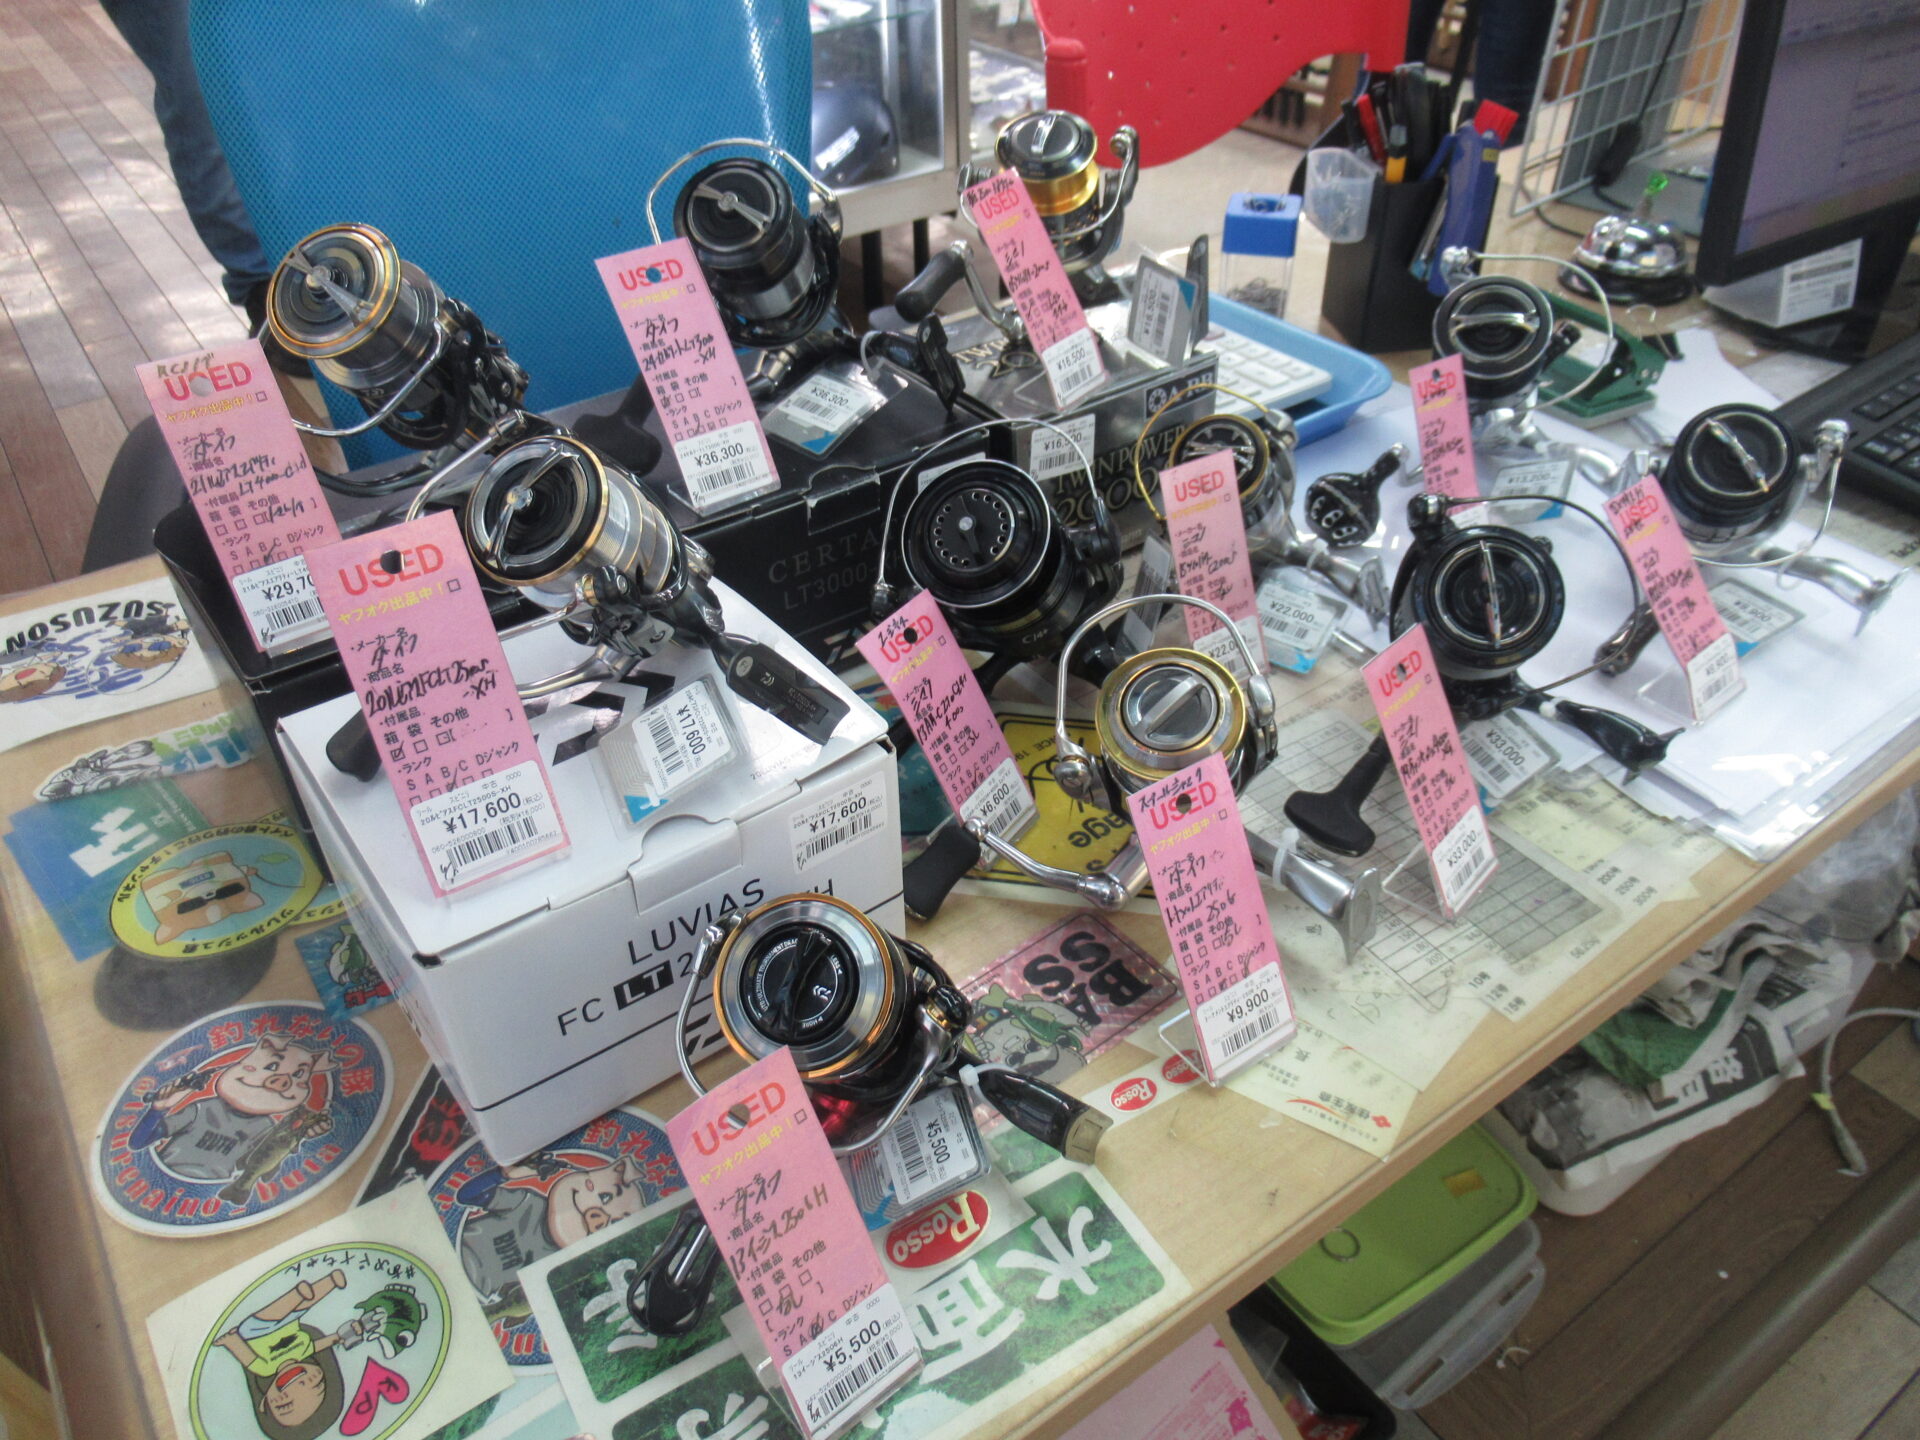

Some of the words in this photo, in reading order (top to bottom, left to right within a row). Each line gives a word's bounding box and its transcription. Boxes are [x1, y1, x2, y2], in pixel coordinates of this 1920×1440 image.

[979, 189, 1020, 219] USED
[618, 259, 684, 291] USED
[163, 362, 252, 401] UED
[810, 386, 849, 407] ¥36,300
[1417, 373, 1457, 399] USED
[694, 442, 744, 468] ¥36,300
[1174, 471, 1225, 502] USED
[1621, 495, 1659, 531] USED
[338, 543, 444, 596] USED
[768, 528, 884, 584] CERTA
[338, 583, 443, 626] ヤフオク出品中！
[1269, 600, 1315, 625] ¥22,000
[1, 600, 167, 655] SUZUSON
[880, 615, 933, 663] USED
[1379, 650, 1423, 697] USED
[384, 731, 399, 746] 箱
[407, 723, 422, 738] 袋
[430, 707, 470, 728] その他
[676, 703, 706, 756] ¥17,600
[1485, 728, 1526, 768] ¥33,000
[407, 778, 416, 791] S
[425, 773, 434, 785] A
[441, 766, 451, 779] B
[458, 759, 468, 772] C
[443, 792, 522, 834] ¥17,600
[809, 796, 867, 833] ¥17,600
[980, 783, 1010, 817] ¥6,600
[1150, 781, 1217, 830] USED
[1447, 829, 1478, 868] ¥33,000
[627, 877, 765, 966] LUVIAS
[556, 998, 606, 1036] FC
[612, 959, 675, 1012] LT
[1227, 988, 1269, 1024] ¥9,900
[1114, 1078, 1153, 1108] ROSSO
[692, 1081, 786, 1156] USED
[701, 1116, 793, 1186] ヤフオク出品中！
[925, 1118, 951, 1164] ¥5,500
[892, 1191, 981, 1263] ROSSO
[751, 1284, 766, 1300] 箱
[771, 1269, 787, 1286] 袋
[791, 1239, 827, 1268] その他
[782, 1345, 793, 1357] S
[798, 1333, 808, 1347] A
[828, 1309, 838, 1323] C
[841, 1283, 874, 1311] Dジャン
[845, 1312, 861, 1326] 中古
[823, 1319, 882, 1372] ¥5,500
